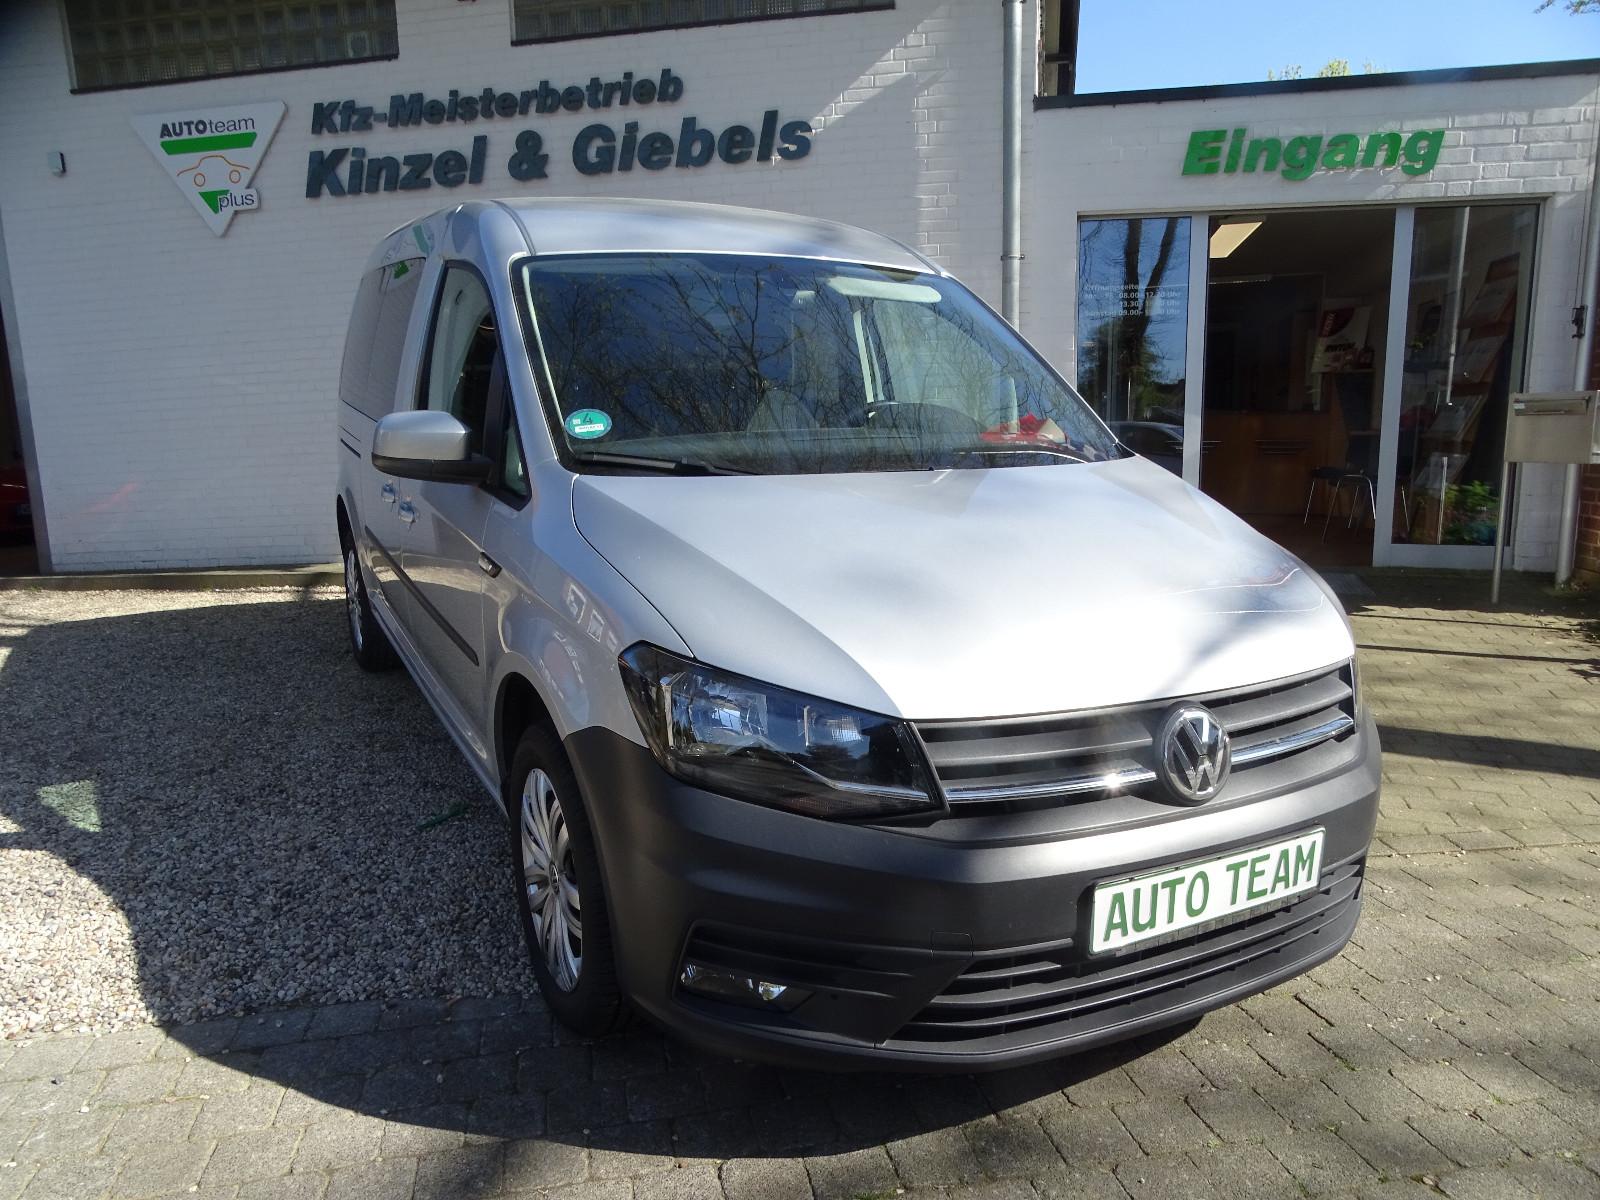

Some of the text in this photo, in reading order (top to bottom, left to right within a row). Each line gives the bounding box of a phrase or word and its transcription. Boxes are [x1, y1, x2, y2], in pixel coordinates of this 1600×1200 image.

[159, 117, 256, 139] AUTOteam
[311, 68, 684, 135] Kfz-Meisterbetrieb
[306, 109, 813, 198] Kinzel & Giebels
[1181, 128, 1446, 182] Eingang
[218, 192, 255, 212] plus
[582, 412, 593, 424] 4
[1103, 839, 1317, 942] AUTO TEAM
